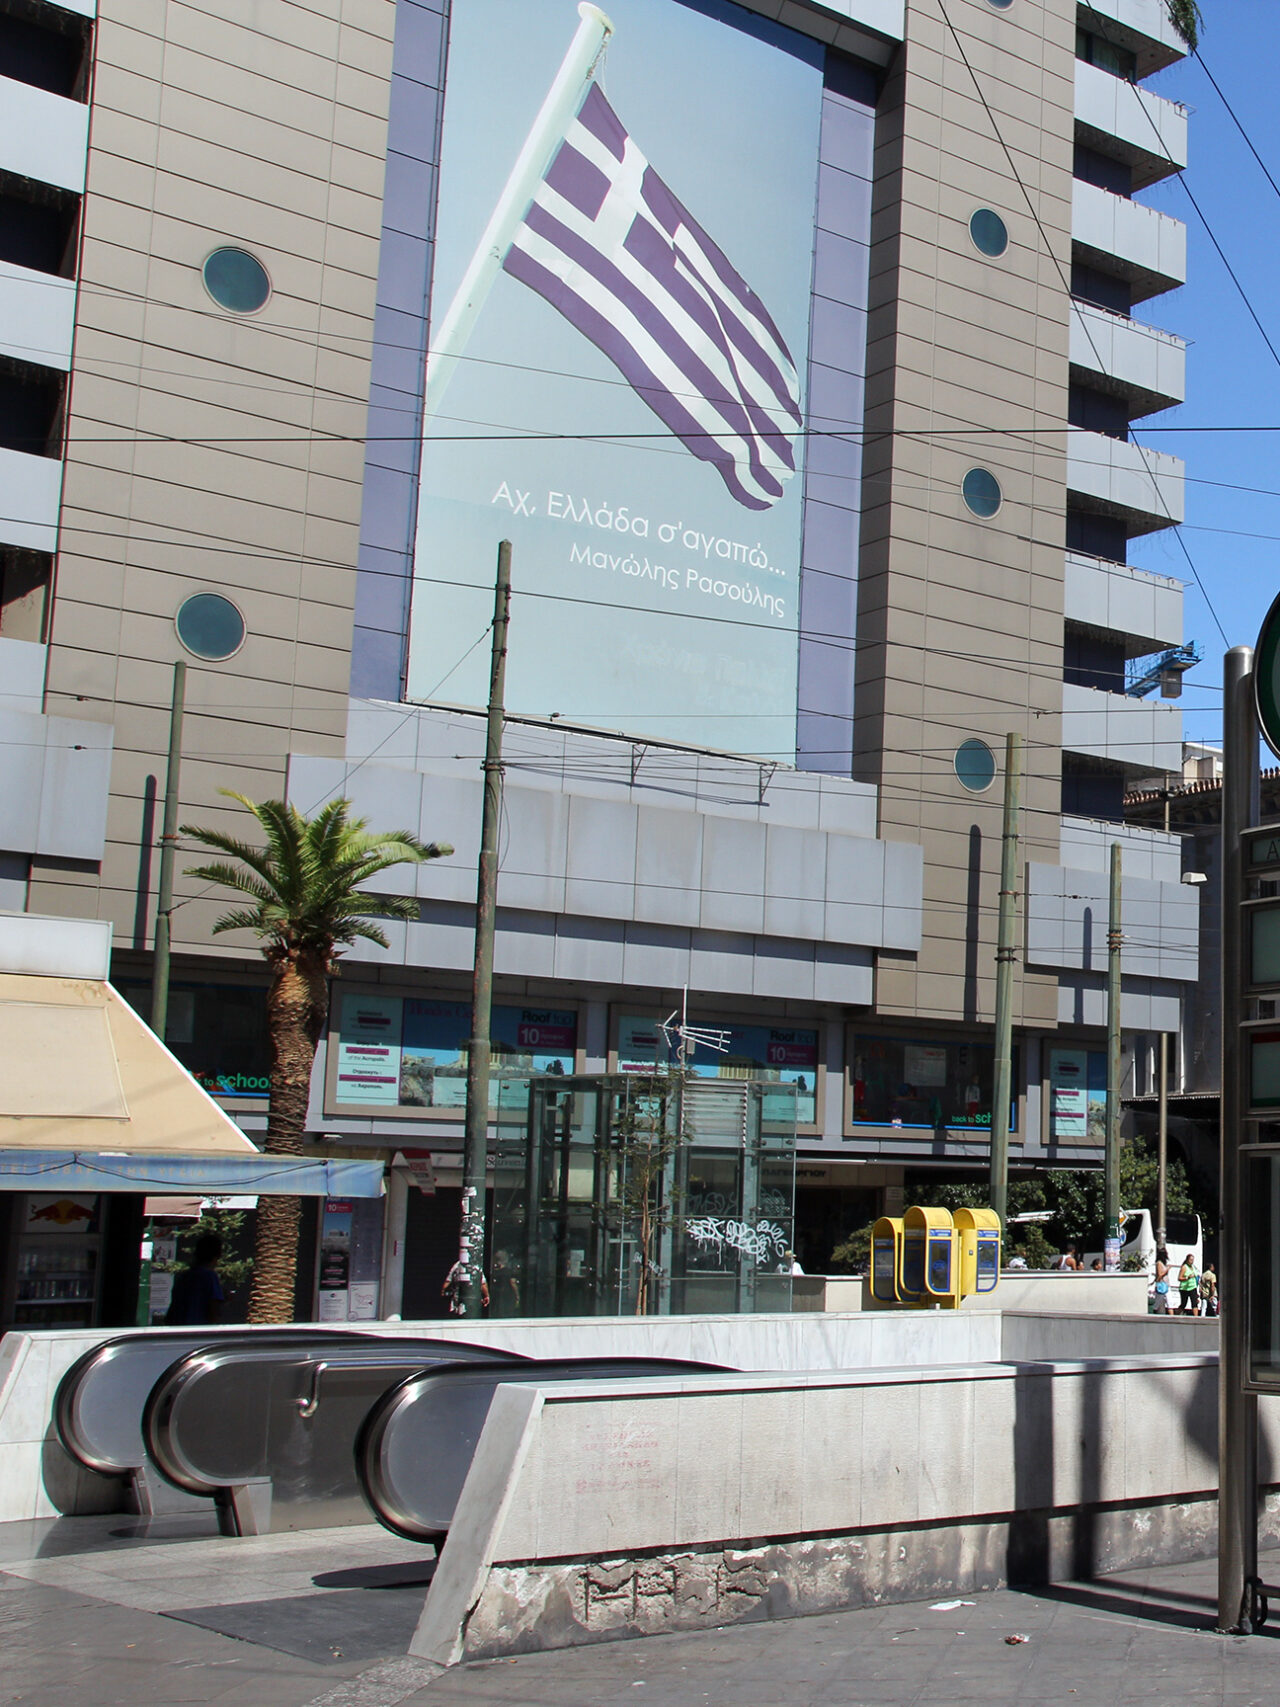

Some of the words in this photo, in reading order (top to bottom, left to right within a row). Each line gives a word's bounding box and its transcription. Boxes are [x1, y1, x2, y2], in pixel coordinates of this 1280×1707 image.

[492, 480, 537, 517] Αχ,
[547, 491, 649, 537] Ελλάδα
[569, 543, 680, 590] Μανώλης
[686, 568, 786, 618] Ρασούλης
[521, 1027, 540, 1045] 10
[770, 1047, 786, 1060] 10
[215, 1073, 270, 1089] schoo
